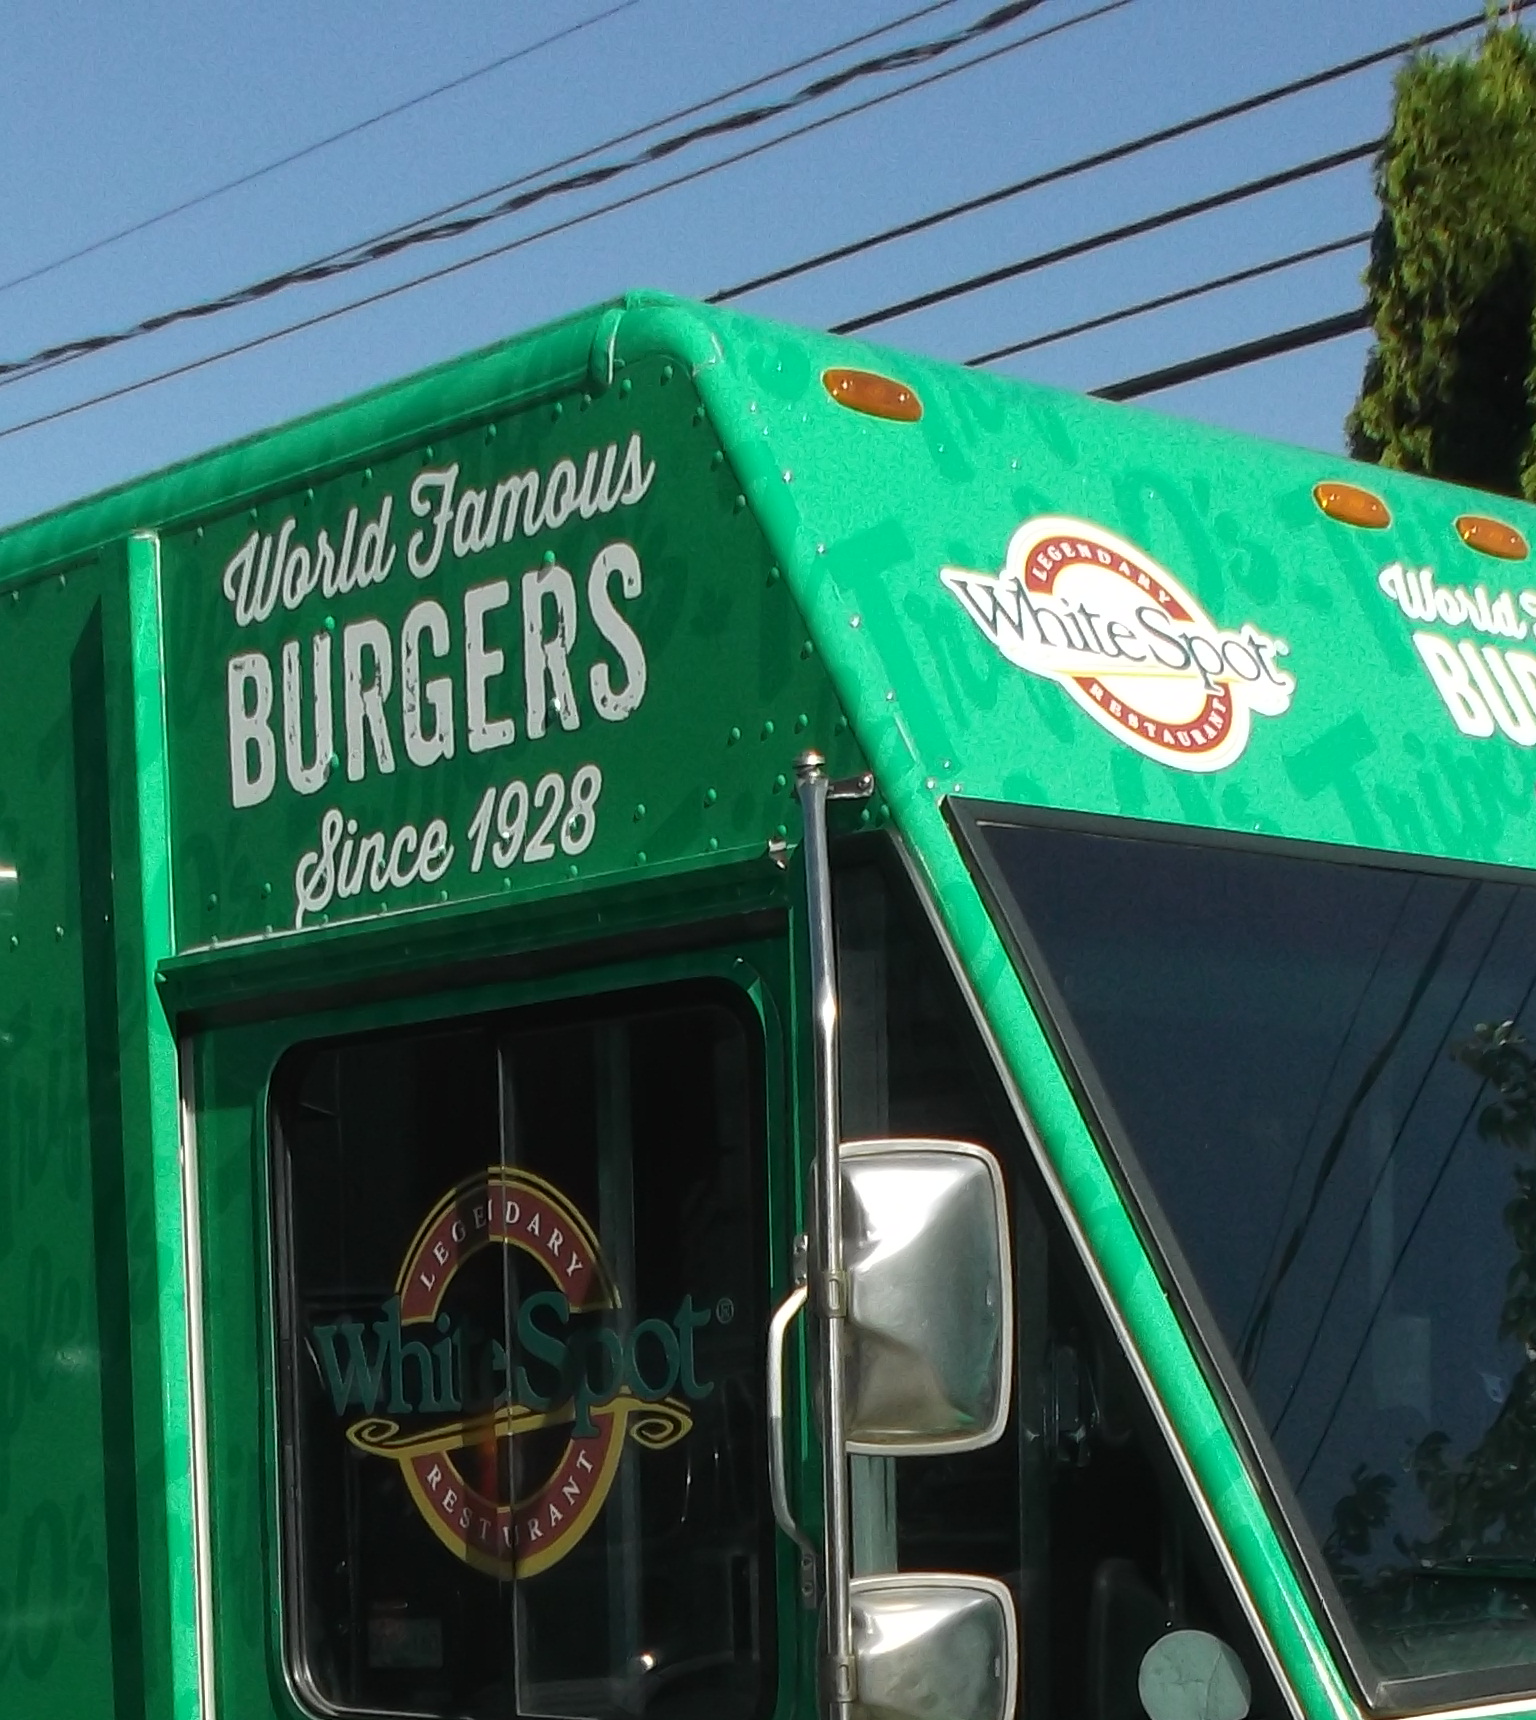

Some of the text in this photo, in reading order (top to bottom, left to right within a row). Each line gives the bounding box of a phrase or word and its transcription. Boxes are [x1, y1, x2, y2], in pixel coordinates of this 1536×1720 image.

[223, 433, 655, 626] World Famous
[1032, 542, 1171, 602] LEGENDARY
[1380, 562, 1528, 640] World
[227, 542, 647, 809] BURGERS
[295, 765, 602, 930] Since 1928
